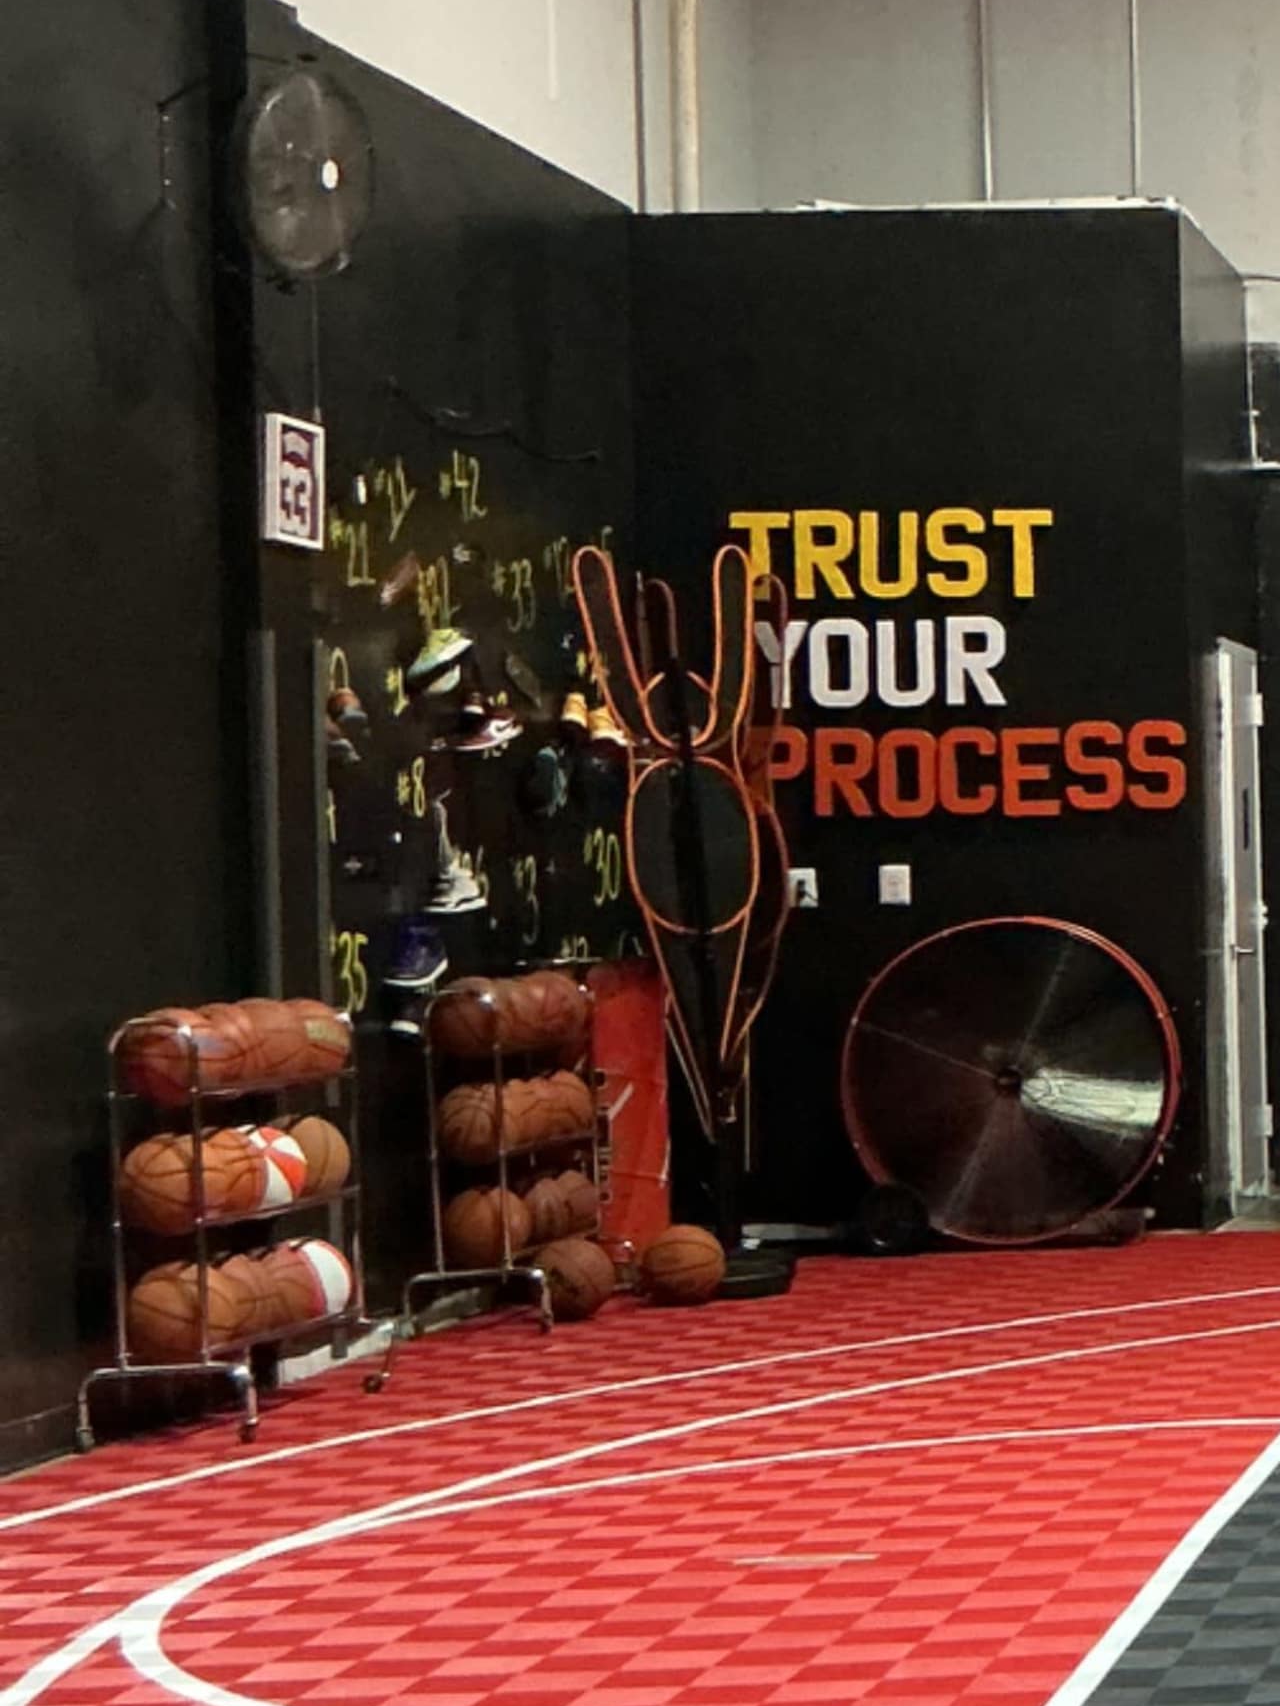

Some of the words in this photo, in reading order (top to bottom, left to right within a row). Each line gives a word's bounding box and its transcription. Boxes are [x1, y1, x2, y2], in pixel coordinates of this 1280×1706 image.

[728, 507, 1053, 600] TRUST
[752, 615, 1007, 709] YOUR
[746, 720, 1188, 819] PROCESS
